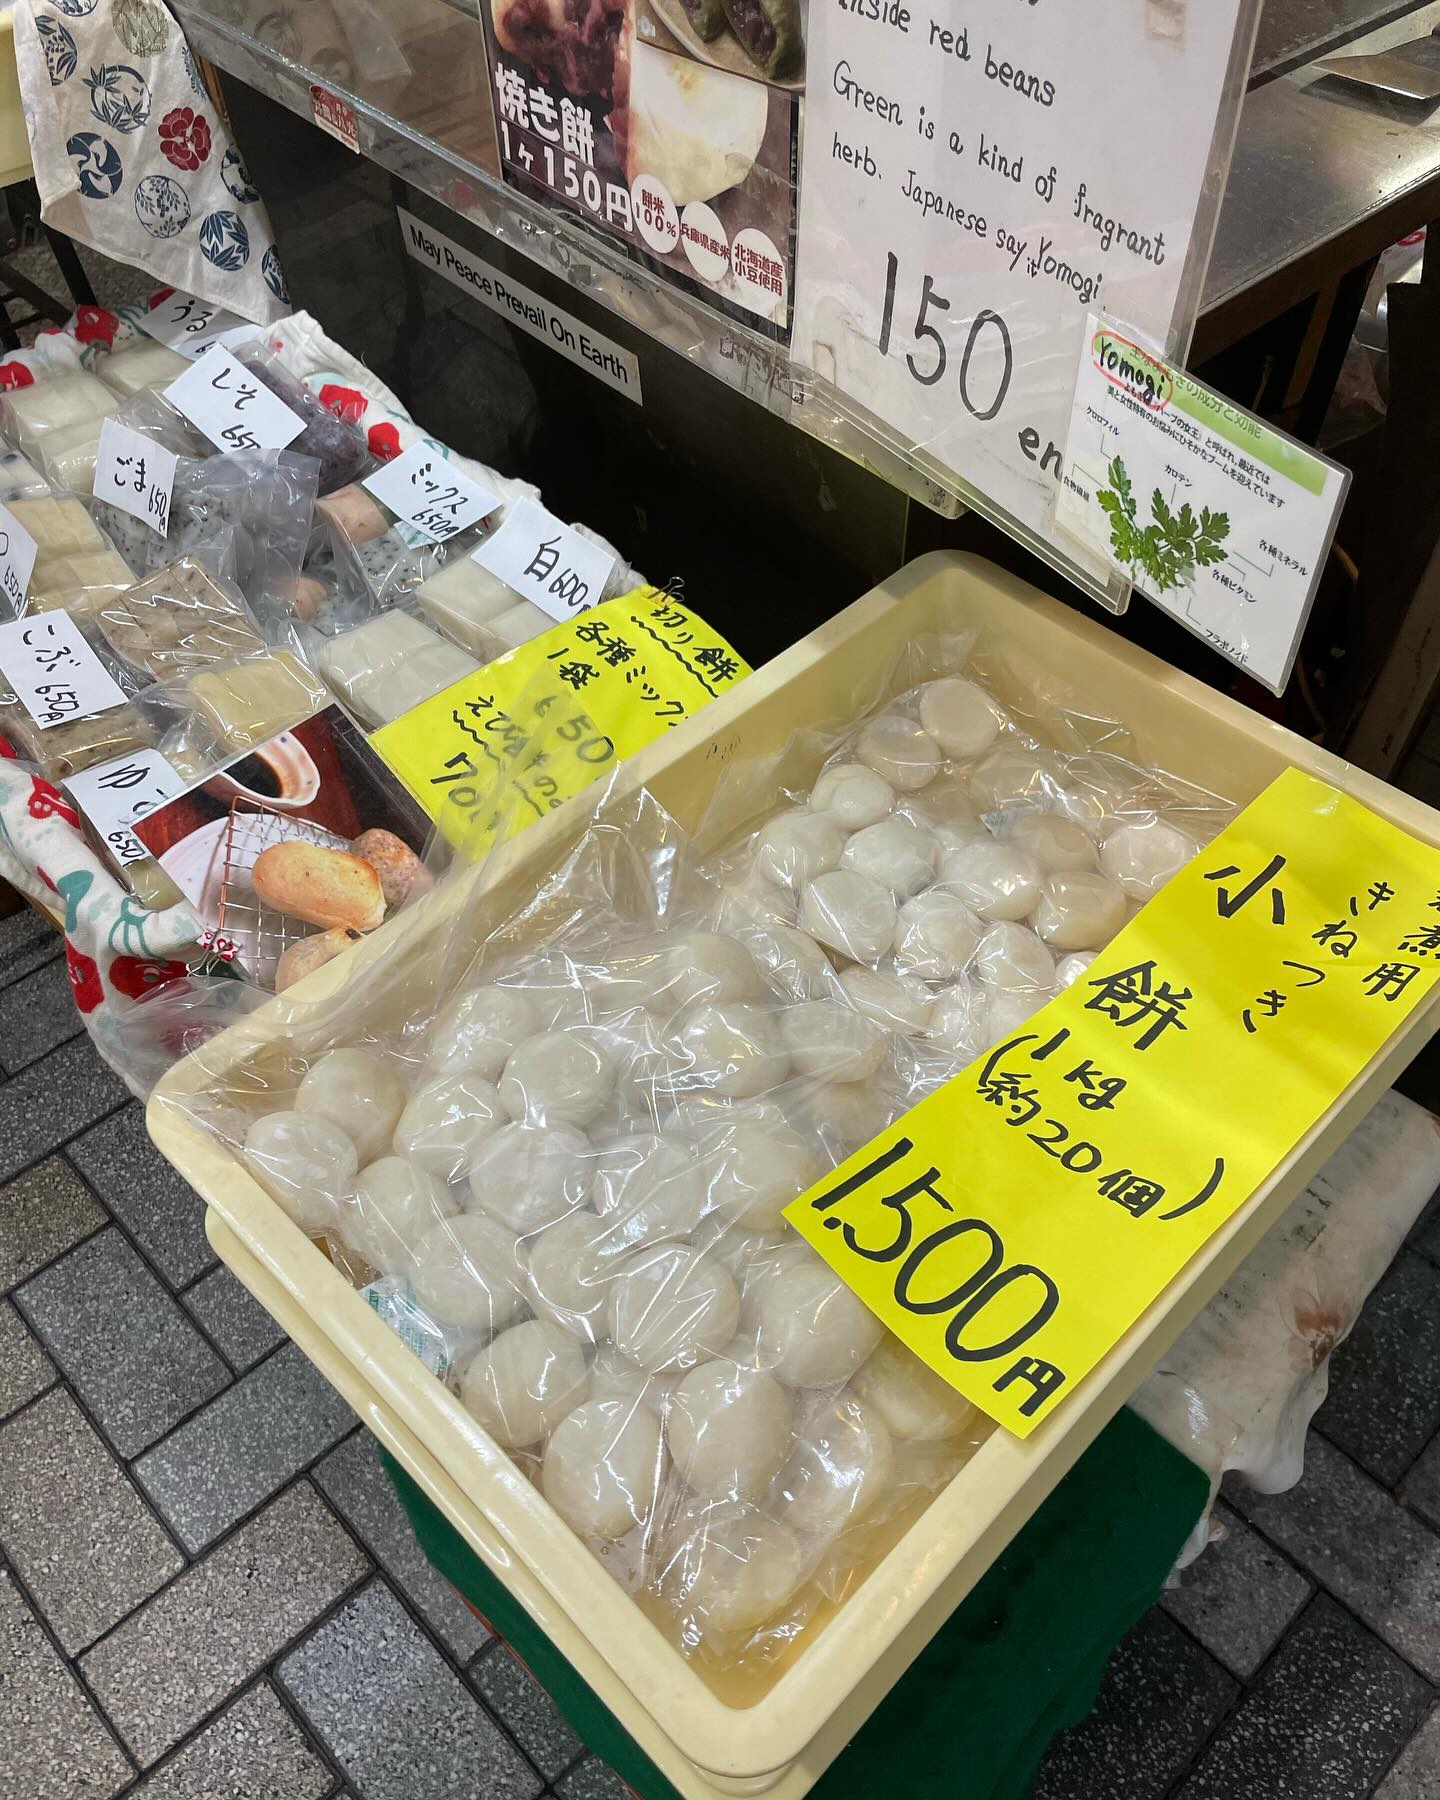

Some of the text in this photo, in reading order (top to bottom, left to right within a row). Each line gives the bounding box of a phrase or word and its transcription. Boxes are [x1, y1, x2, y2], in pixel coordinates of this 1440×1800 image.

[930, 19, 971, 61] red
[984, 43, 1056, 107] beans
[495, 63, 597, 167] 焼き餅
[833, 60, 1166, 266] Green is a kind of fragrant
[901, 169, 987, 238] Japanese
[996, 228, 1027, 272] say
[734, 243, 783, 280] 北海道産
[735, 261, 783, 297] 小豆使用
[409, 223, 628, 384] May Peace Prevail On Earth
[878, 251, 1013, 421] 150
[1099, 336, 1166, 406] Yomogi
[114, 456, 147, 492] ごま
[1164, 463, 1193, 488] カロテン
[523, 536, 562, 582] 白
[650, 605, 740, 683] 切り餅
